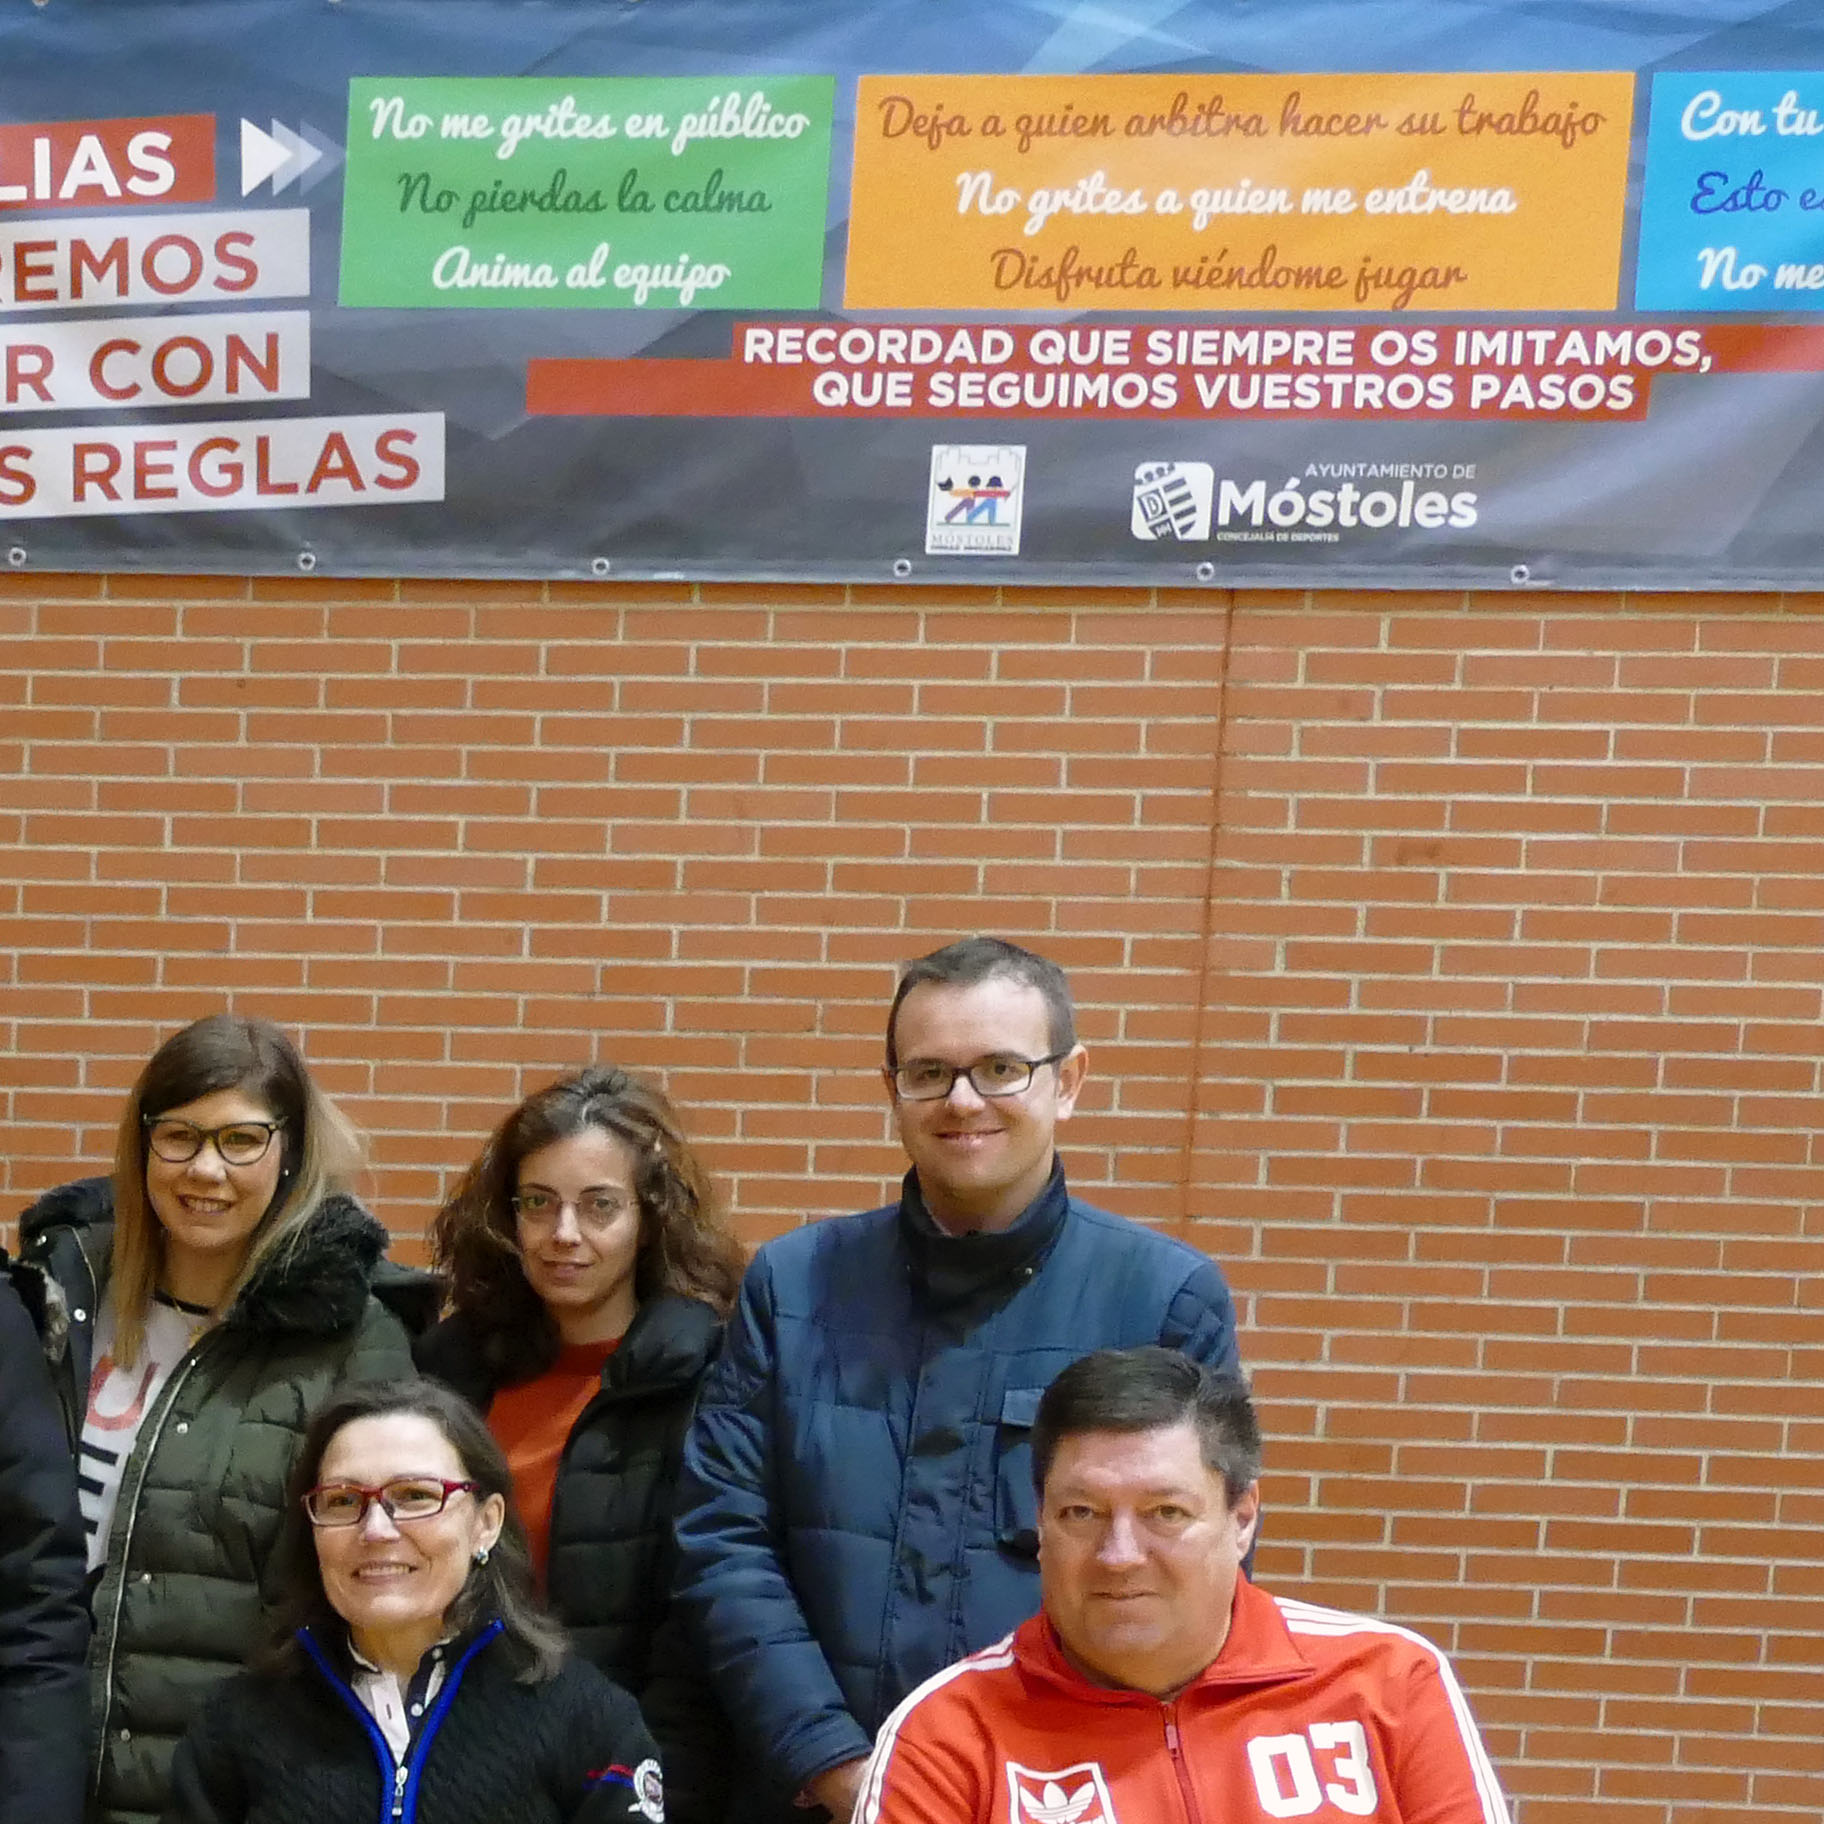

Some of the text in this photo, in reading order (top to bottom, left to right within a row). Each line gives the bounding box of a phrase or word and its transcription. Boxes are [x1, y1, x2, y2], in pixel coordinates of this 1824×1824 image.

[370, 91, 810, 160] No me grites en público
[879, 89, 1607, 154] Deja a quien arbitra hacer su trabajo
[1681, 90, 1824, 141] Con tu
[397, 168, 772, 229] No pierdas la calma
[956, 168, 1517, 236] No grites a quien me entrena
[1690, 169, 1790, 214] Esto
[432, 242, 731, 307] Anima al equipo
[990, 244, 1468, 311] Disfruta viéndome jugar
[1697, 246, 1768, 291] No
[89, 332, 280, 400] CON
[744, 328, 1712, 373] RECORDAD QUE SIEMPRE OS IMITAMOS,
[812, 372, 1635, 410] QUE SEGUIMOS VUESTROS PASOS
[72, 428, 421, 503] REGLAS
[1305, 463, 1476, 479] AYUNTAMIENTO DE
[1218, 477, 1477, 528] Móstoles
[1247, 1720, 1378, 1818] 03
